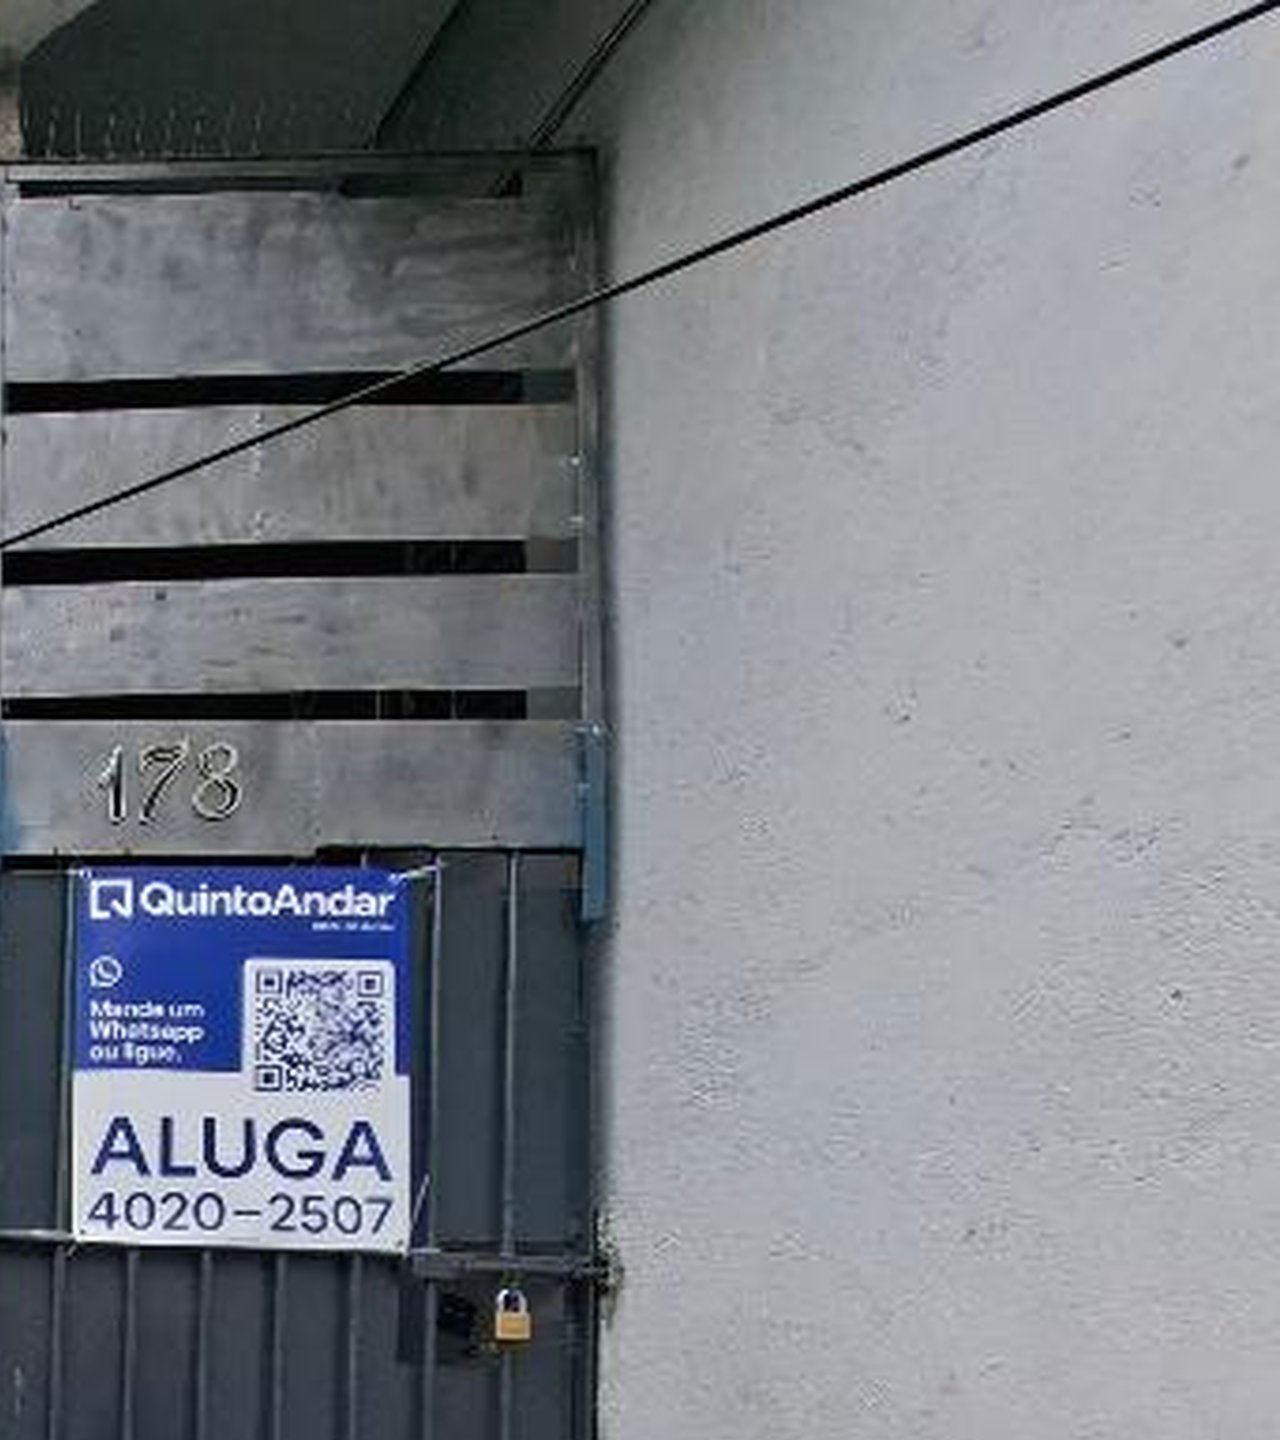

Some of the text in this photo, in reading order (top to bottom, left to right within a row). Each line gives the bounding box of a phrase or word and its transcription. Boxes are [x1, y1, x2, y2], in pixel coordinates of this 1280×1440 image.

[96, 733, 241, 826] 178
[139, 881, 396, 918] QuintoAndar
[168, 1003, 206, 1018] um
[89, 1045, 120, 1060] ou
[89, 1115, 394, 1182] ALUGA
[88, 1191, 394, 1235] 4020-2507
